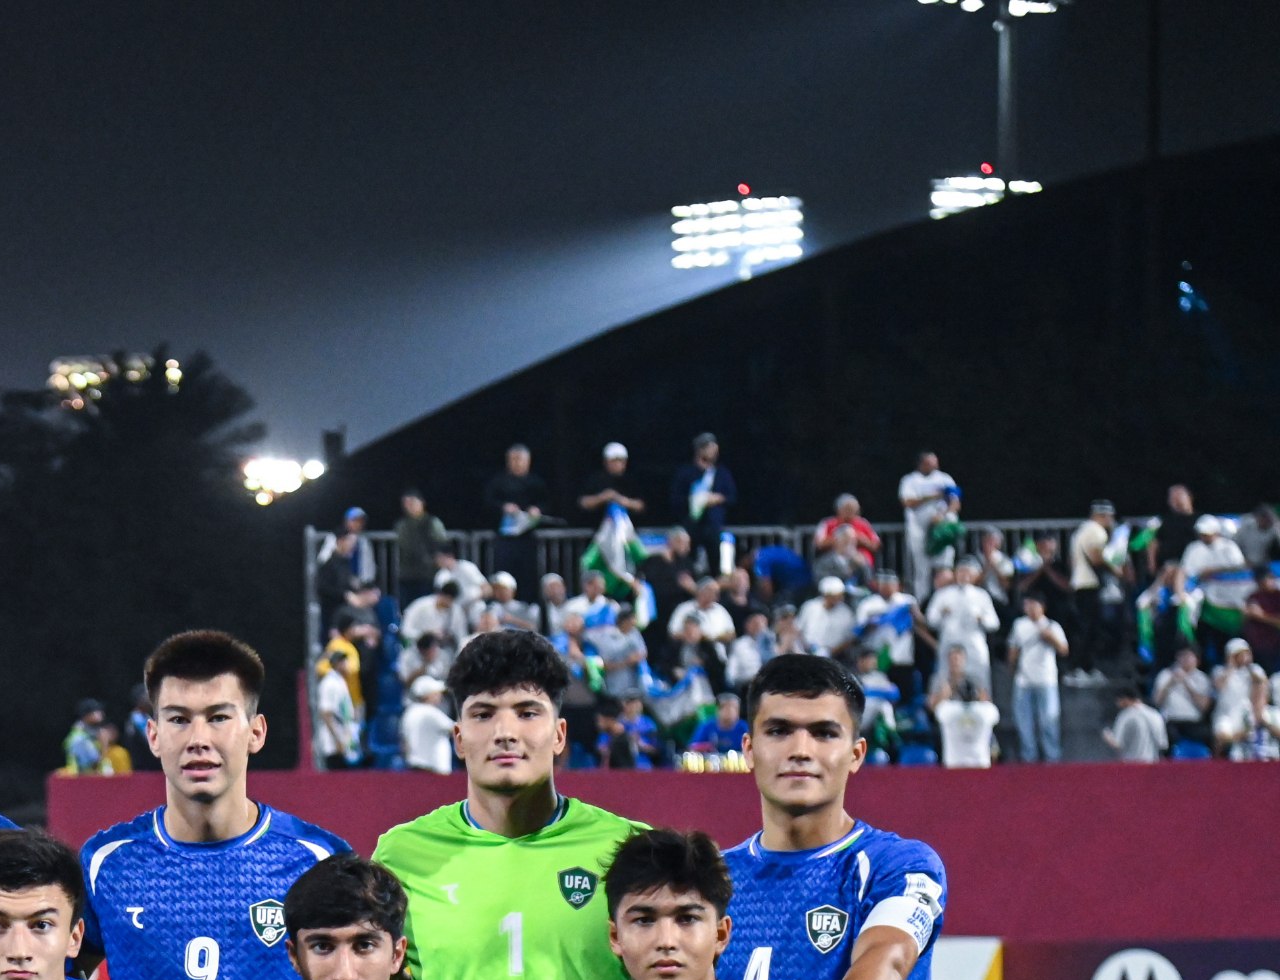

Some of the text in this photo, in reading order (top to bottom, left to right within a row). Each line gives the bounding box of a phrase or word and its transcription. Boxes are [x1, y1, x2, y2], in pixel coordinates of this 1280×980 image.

[565, 875, 591, 890] UFA
[256, 909, 285, 925] UFA
[812, 915, 841, 931] UFA
[499, 912, 524, 977] 1
